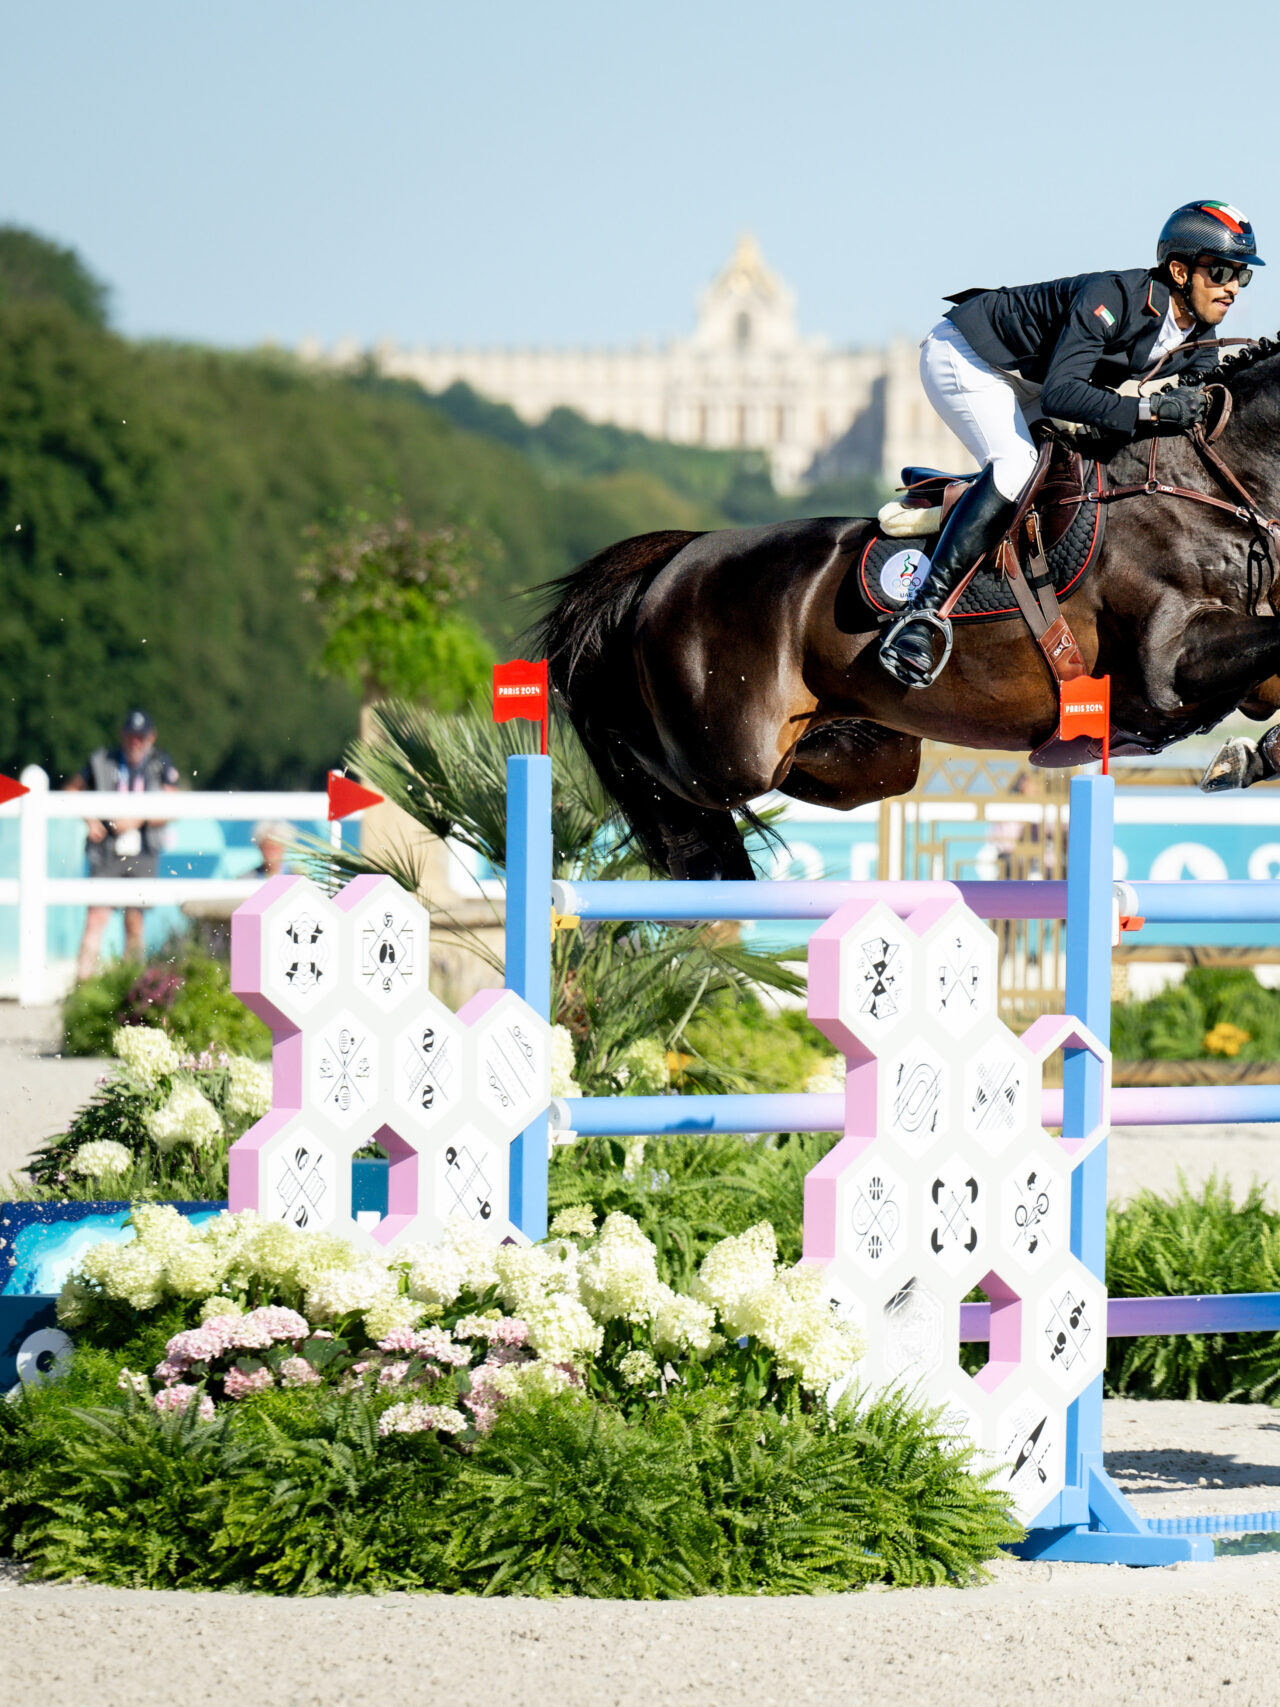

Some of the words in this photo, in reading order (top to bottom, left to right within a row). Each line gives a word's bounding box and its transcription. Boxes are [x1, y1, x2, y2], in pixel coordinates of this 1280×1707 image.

[498, 687, 520, 695] PARIS
[521, 686, 540, 695] 2024
[1086, 703, 1103, 712] 2024
